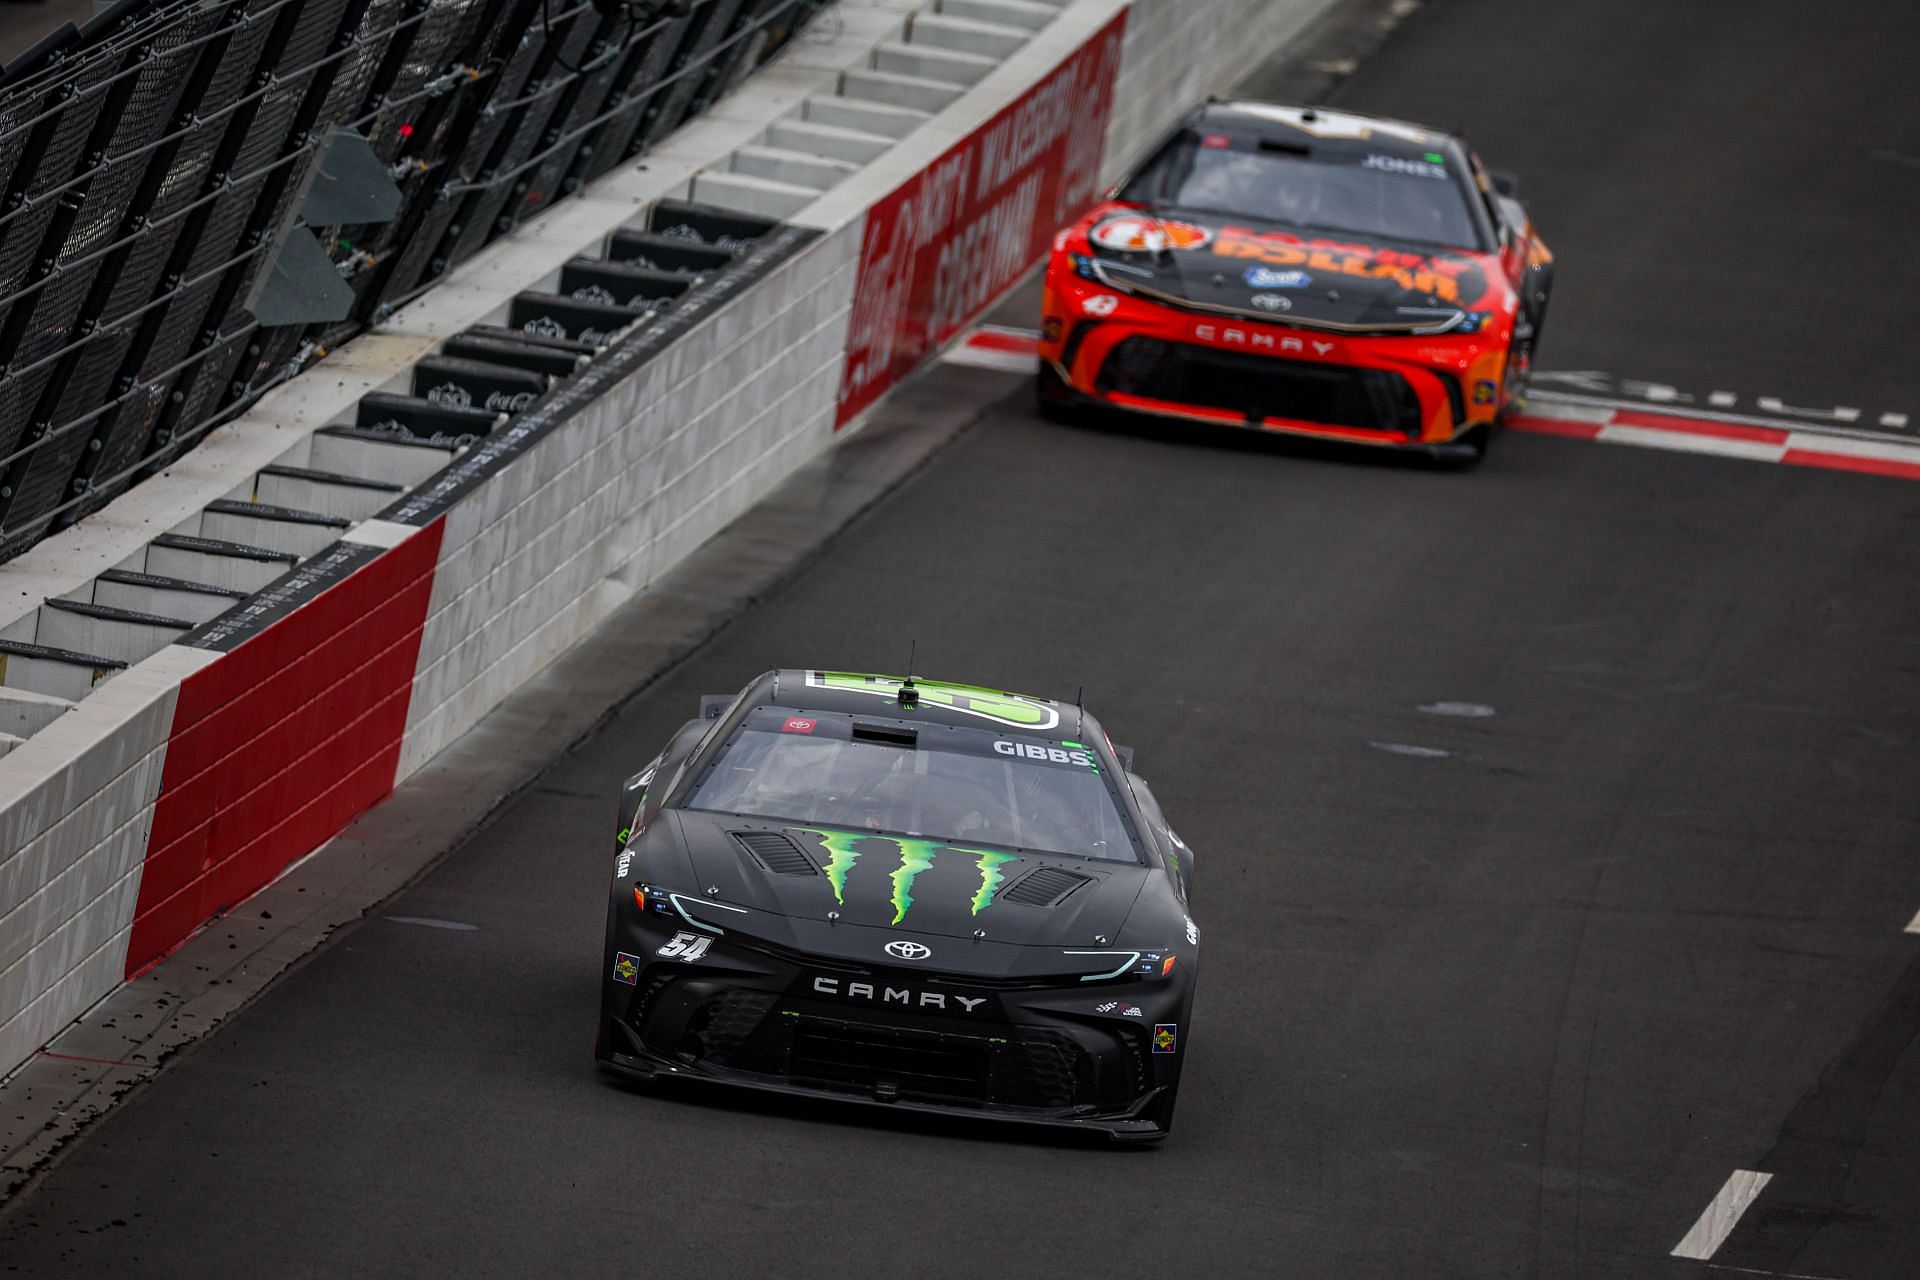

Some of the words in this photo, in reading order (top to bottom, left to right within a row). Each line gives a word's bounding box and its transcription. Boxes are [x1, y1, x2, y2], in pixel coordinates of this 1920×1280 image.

[1361, 153, 1448, 180] JONES
[1195, 324, 1334, 356] CAMRY
[993, 740, 1090, 767] GIBBS
[656, 930, 714, 963] 54
[813, 976, 987, 1012] CAMRY
